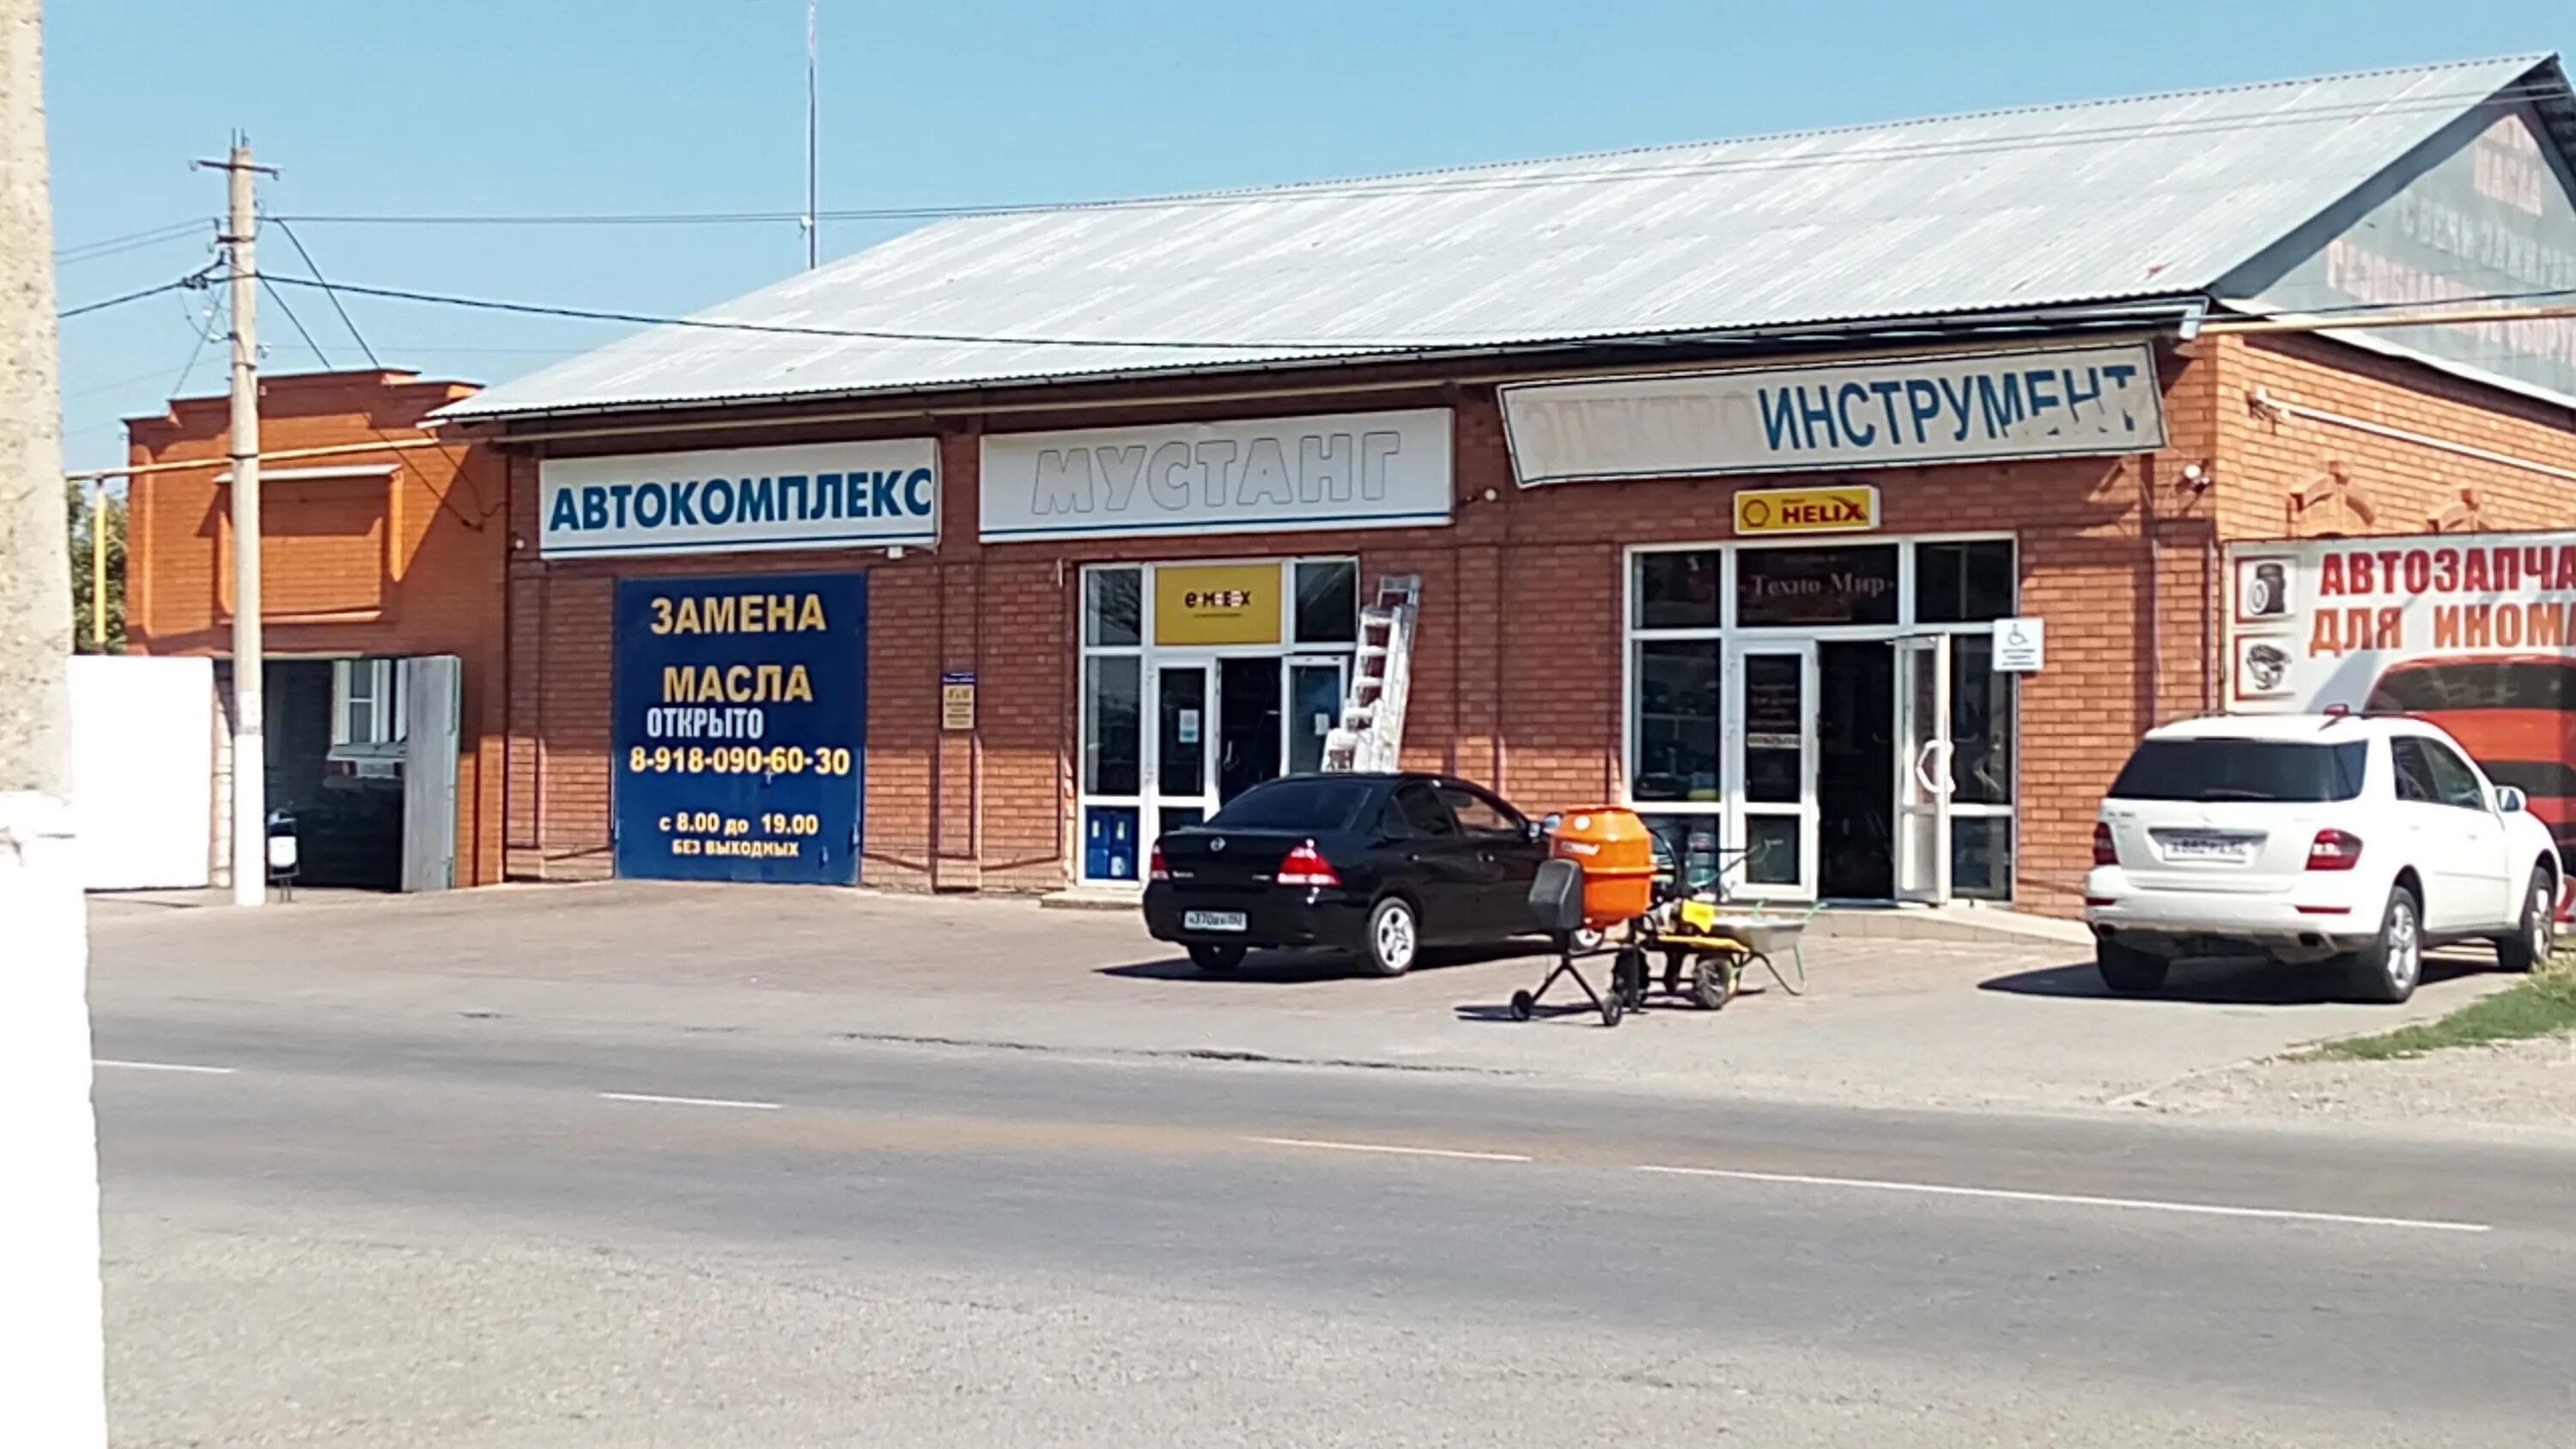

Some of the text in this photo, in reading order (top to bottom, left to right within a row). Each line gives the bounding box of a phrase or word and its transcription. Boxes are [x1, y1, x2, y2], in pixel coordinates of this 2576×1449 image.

[1032, 432, 1400, 515] МУСТАНГ
[549, 469, 933, 531] АВТОКОМПЛЕКС
[1782, 503, 1866, 524] HELIX
[650, 594, 827, 635] ЗАМЕНА
[2309, 606, 2403, 658] ДЛЯ
[663, 665, 813, 703] МАСЛА
[647, 707, 764, 739] ОТКРЫТО
[630, 747, 850, 775] 8-918-090-60-30
[676, 812, 720, 833] 8.00
[724, 816, 749, 836] до
[761, 813, 819, 835] 19.00
[672, 839, 799, 857] БЕЗ ВЫХОДНЫХ
